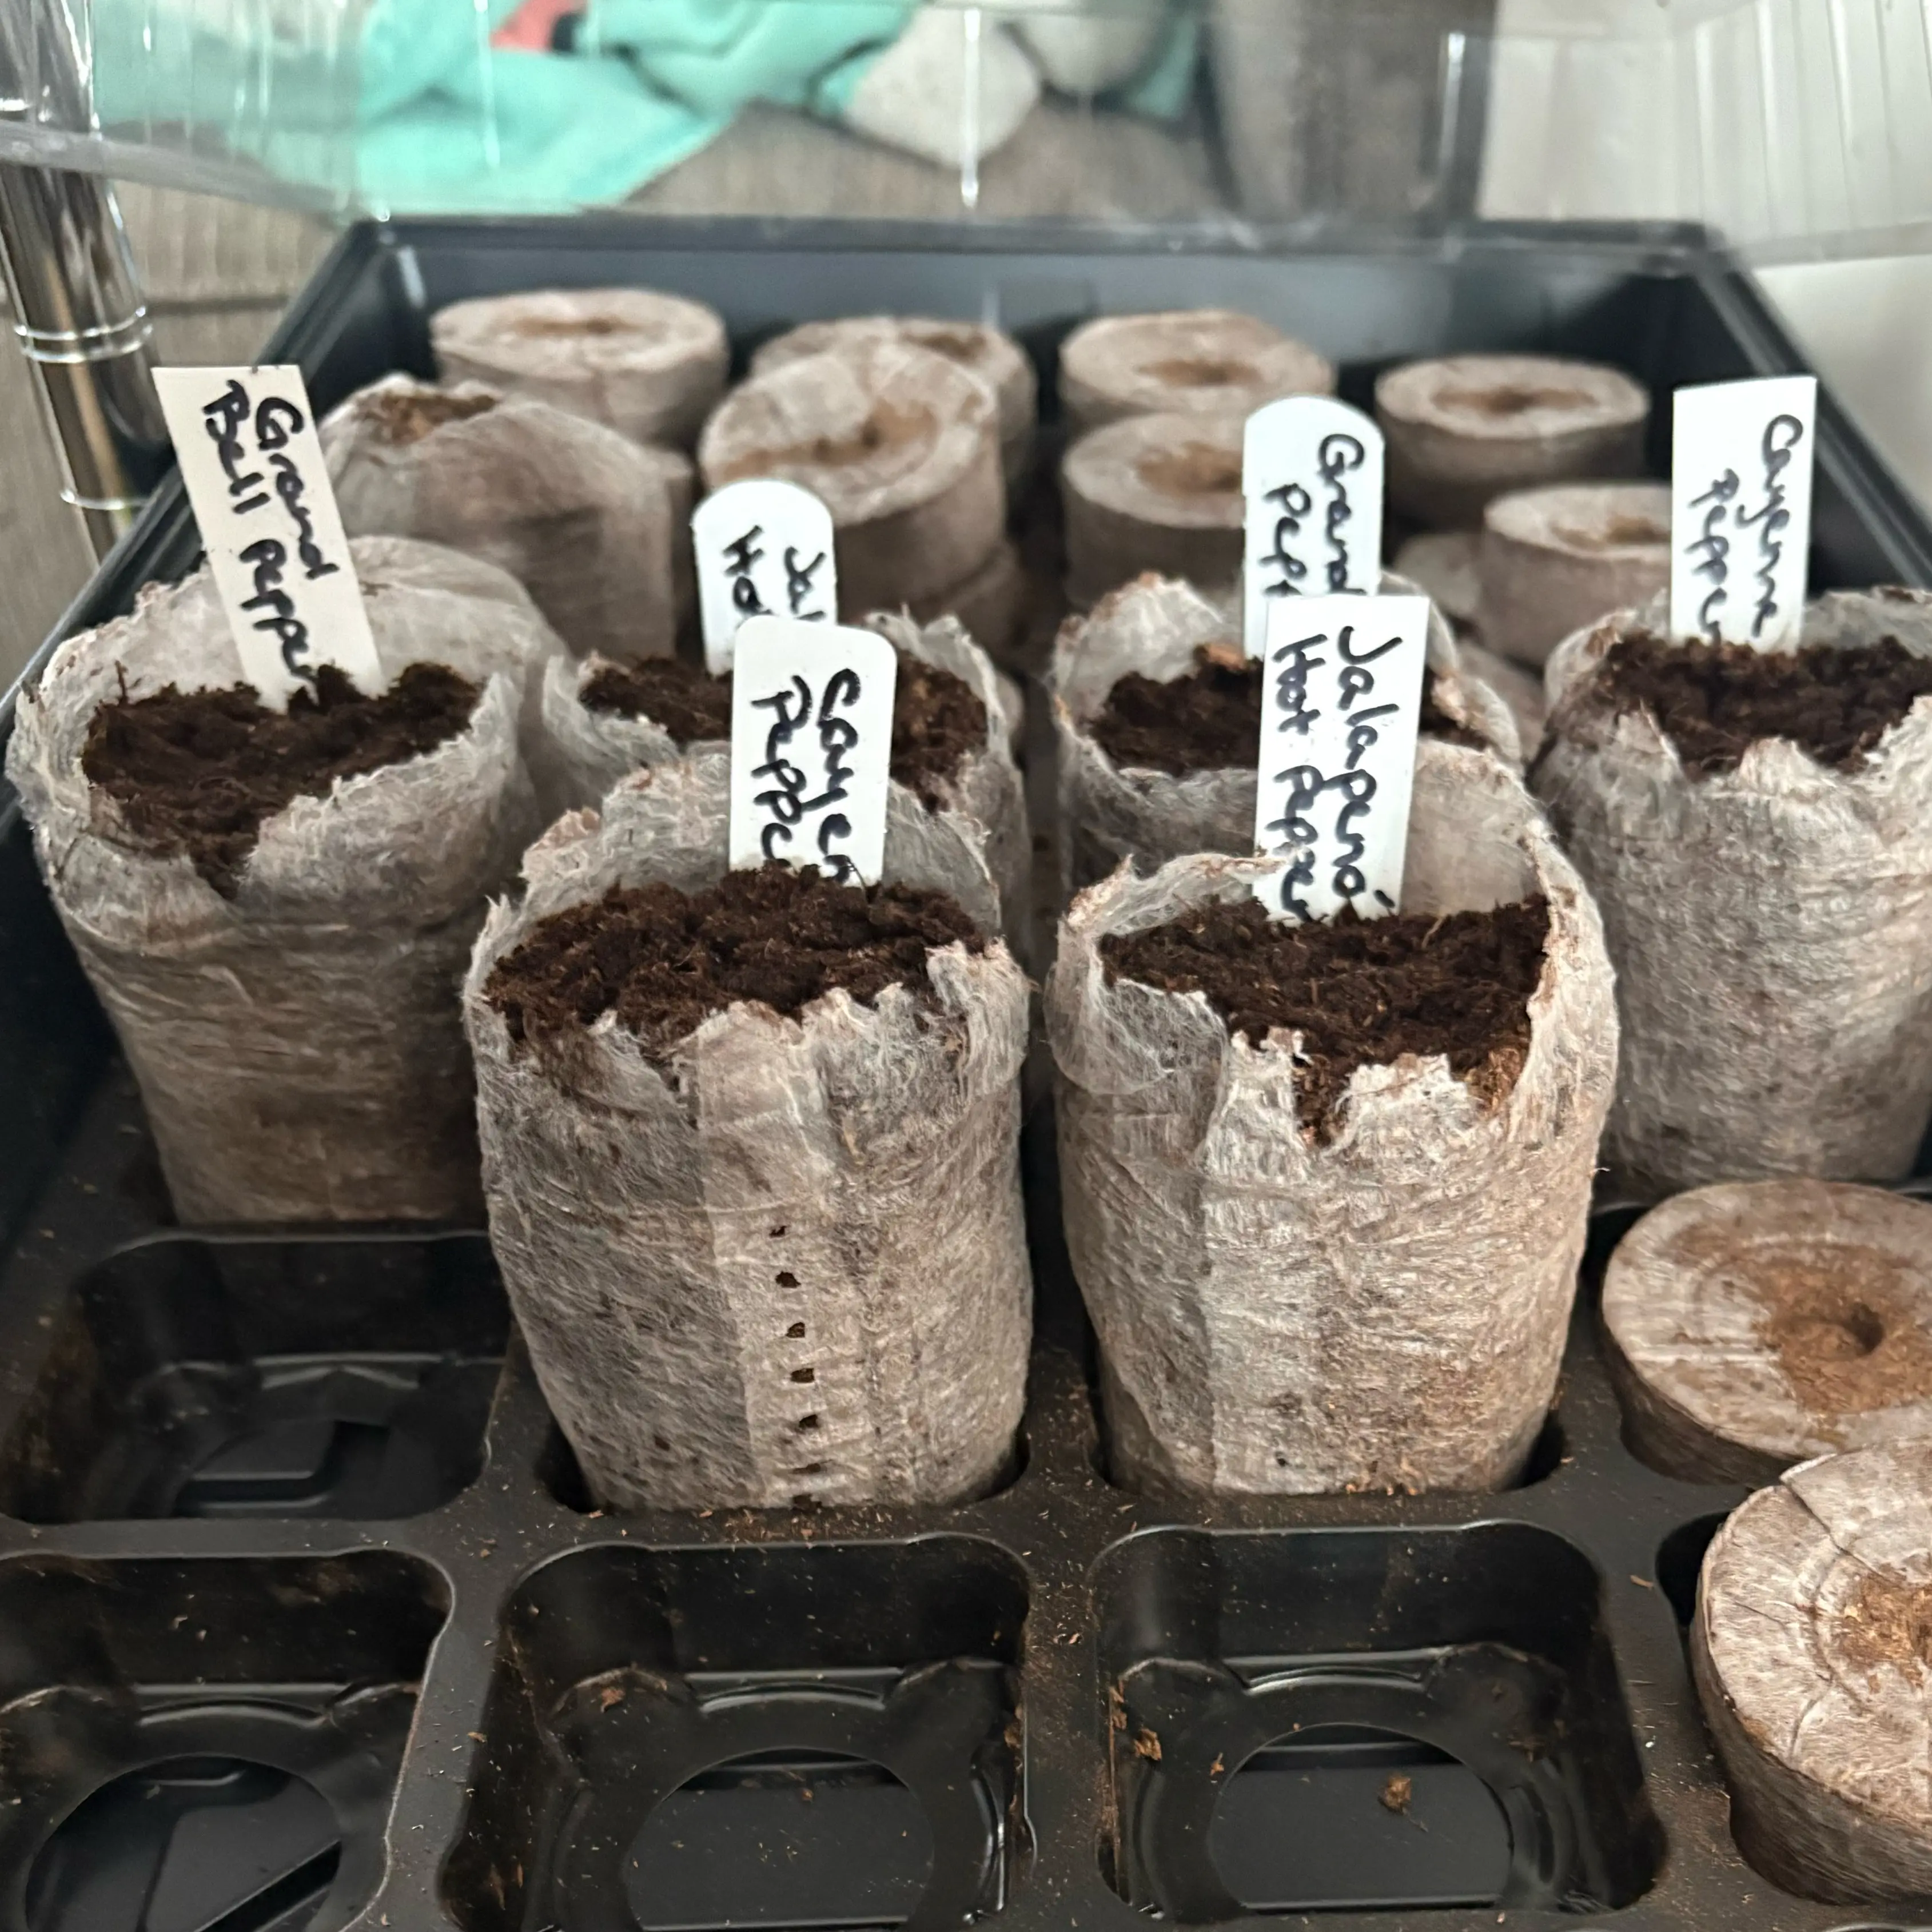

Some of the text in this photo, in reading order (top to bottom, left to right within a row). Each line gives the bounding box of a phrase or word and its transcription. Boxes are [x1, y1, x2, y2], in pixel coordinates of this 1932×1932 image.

[204, 380, 317, 684] Bell Pepper
[256, 397, 340, 580] Grand
[722, 524, 773, 616] Ho
[1318, 433, 1367, 595] Grand
[1684, 468, 1739, 644] Pepper
[1735, 414, 1803, 638] Cayenne
[1265, 634, 1327, 922] Hot Pepper
